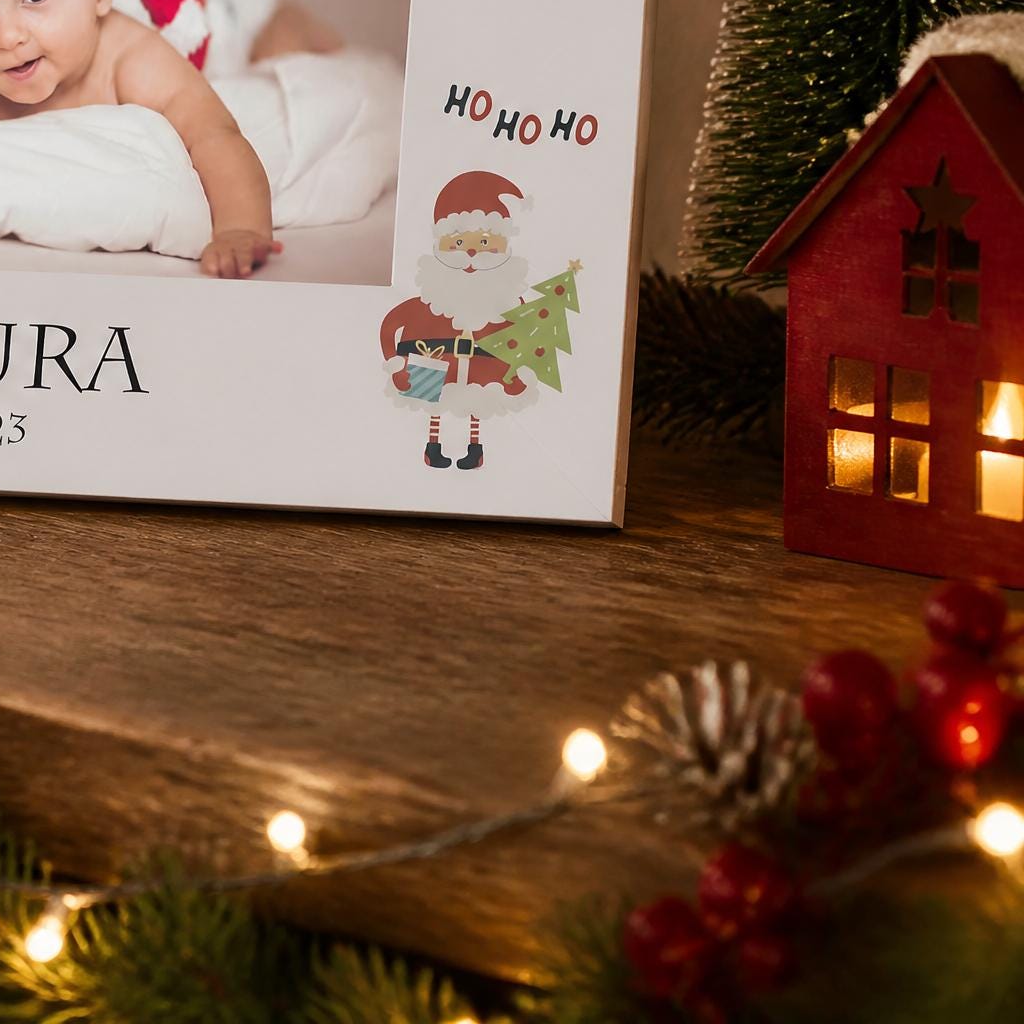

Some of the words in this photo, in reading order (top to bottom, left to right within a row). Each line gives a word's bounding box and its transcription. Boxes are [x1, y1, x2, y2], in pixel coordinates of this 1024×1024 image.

[442, 84, 493, 122] HO
[492, 108, 543, 146] HO
[549, 108, 600, 146] HO
